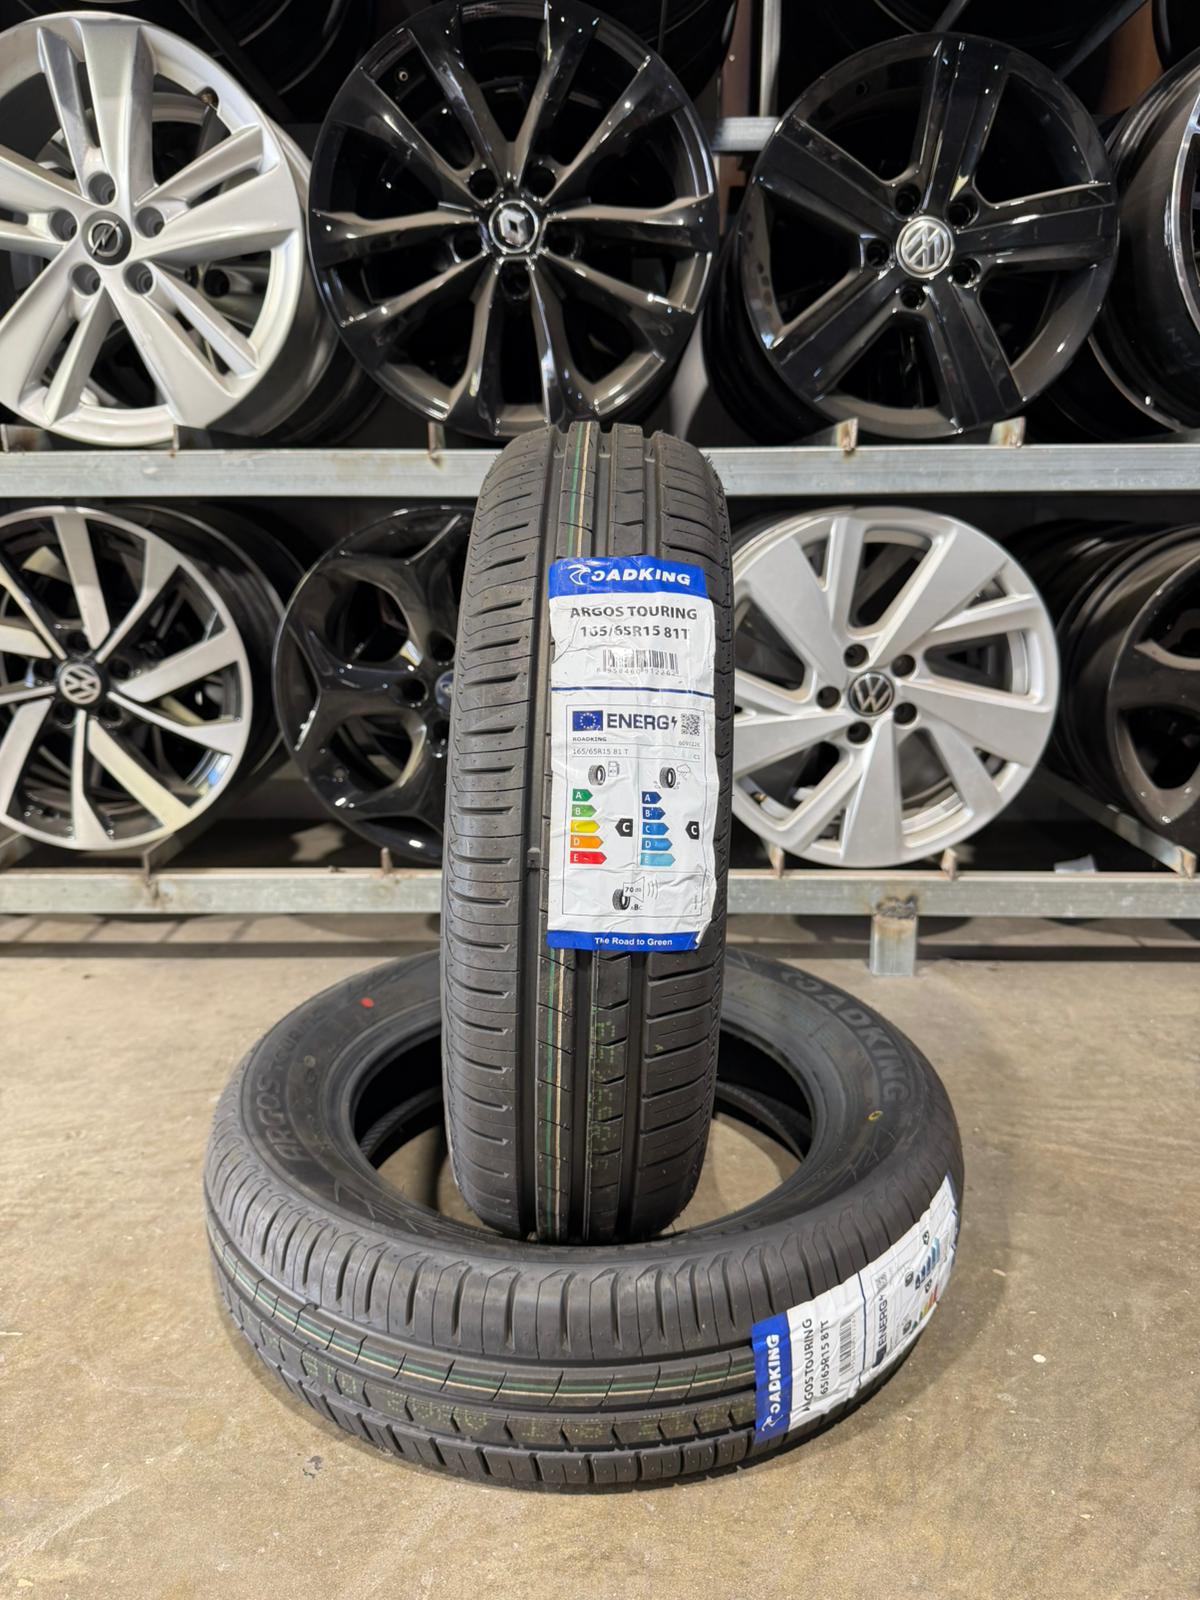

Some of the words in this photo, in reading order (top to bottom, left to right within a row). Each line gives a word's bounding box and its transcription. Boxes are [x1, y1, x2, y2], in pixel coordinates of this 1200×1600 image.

[570, 606, 624, 619] ARGOS
[627, 605, 697, 620] TOURING
[580, 626, 660, 638] 165/65R15
[664, 627, 689, 640] 81T
[607, 713, 669, 730] ENERG
[644, 794, 651, 802] A
[622, 822, 630, 832] C
[691, 825, 697, 835] C
[573, 854, 578, 862] E
[595, 937, 610, 945] The
[612, 937, 635, 945] Road
[637, 937, 645, 945] to
[647, 938, 673, 946] Green
[257, 1076, 312, 1160] ARGOS
[820, 1319, 830, 1341] 81T
[878, 1299, 887, 1347] ENERG
[802, 1318, 815, 1376] TOURING
[820, 1342, 830, 1395] 65/65R15
